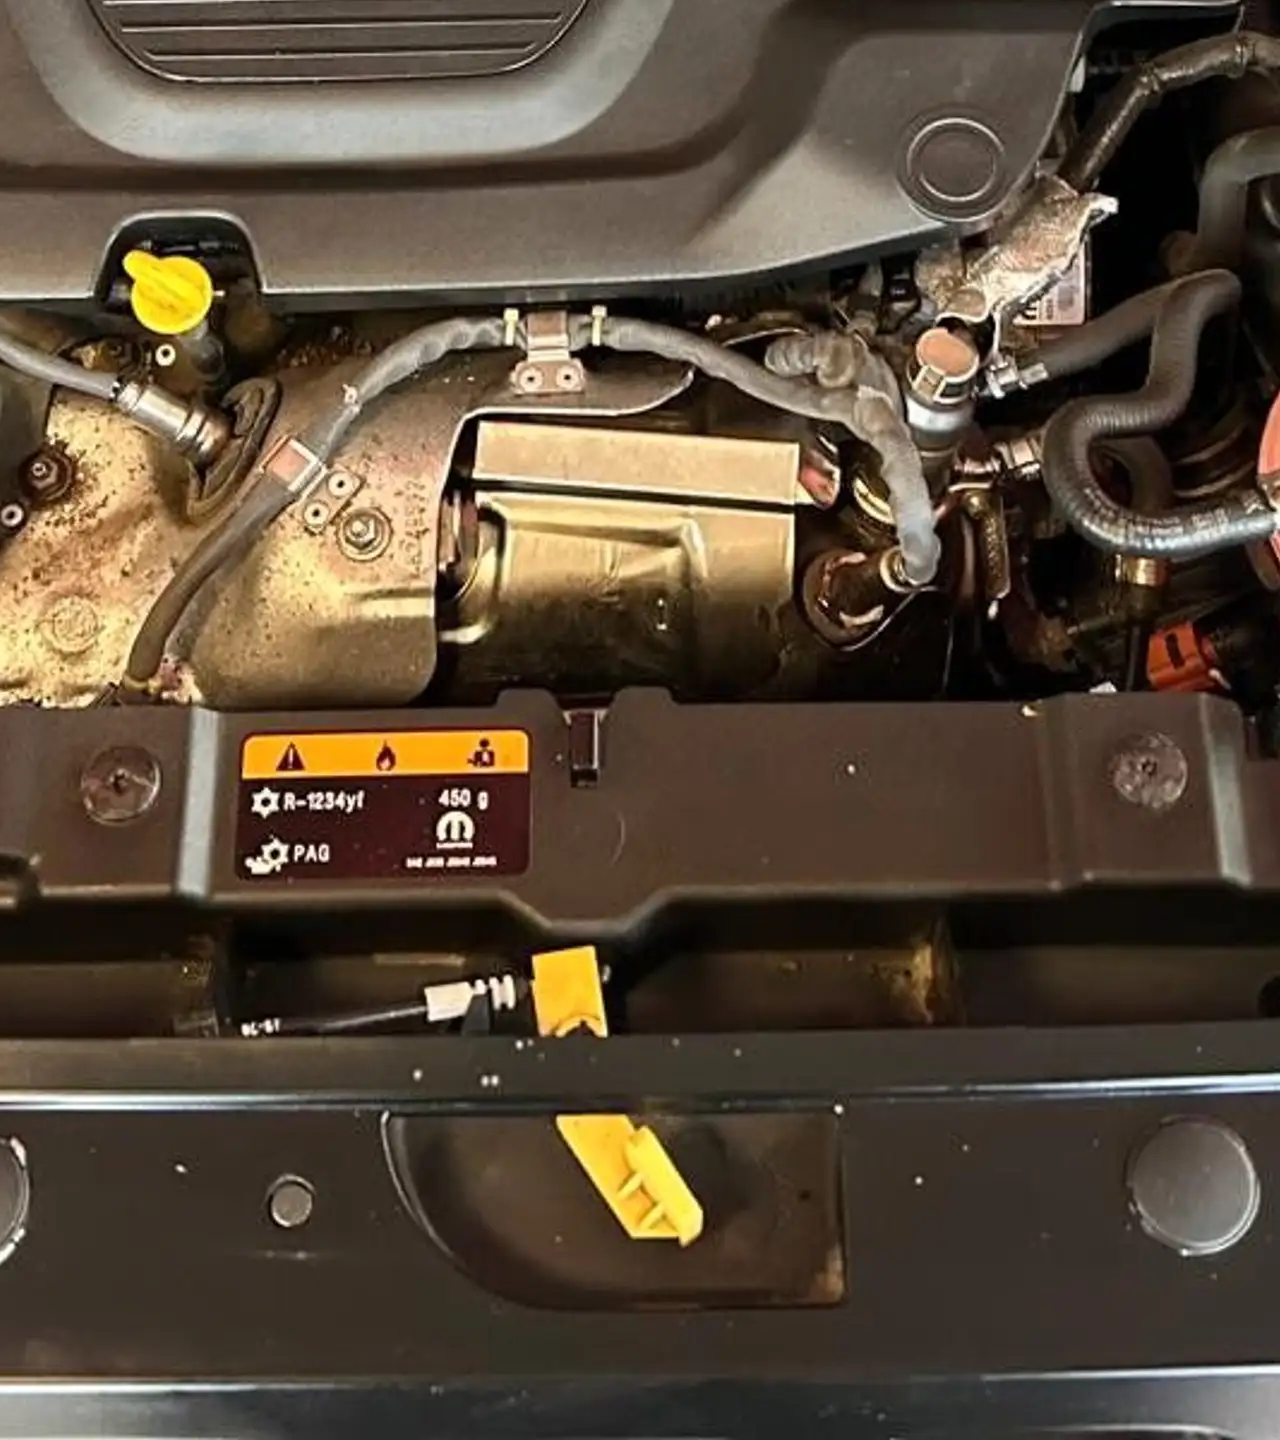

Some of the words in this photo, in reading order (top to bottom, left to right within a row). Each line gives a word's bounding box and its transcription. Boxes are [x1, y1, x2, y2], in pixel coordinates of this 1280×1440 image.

[282, 790, 365, 813] R-1234yf
[437, 788, 472, 808] 450
[477, 790, 489, 810] g
[293, 843, 331, 863] PAG
